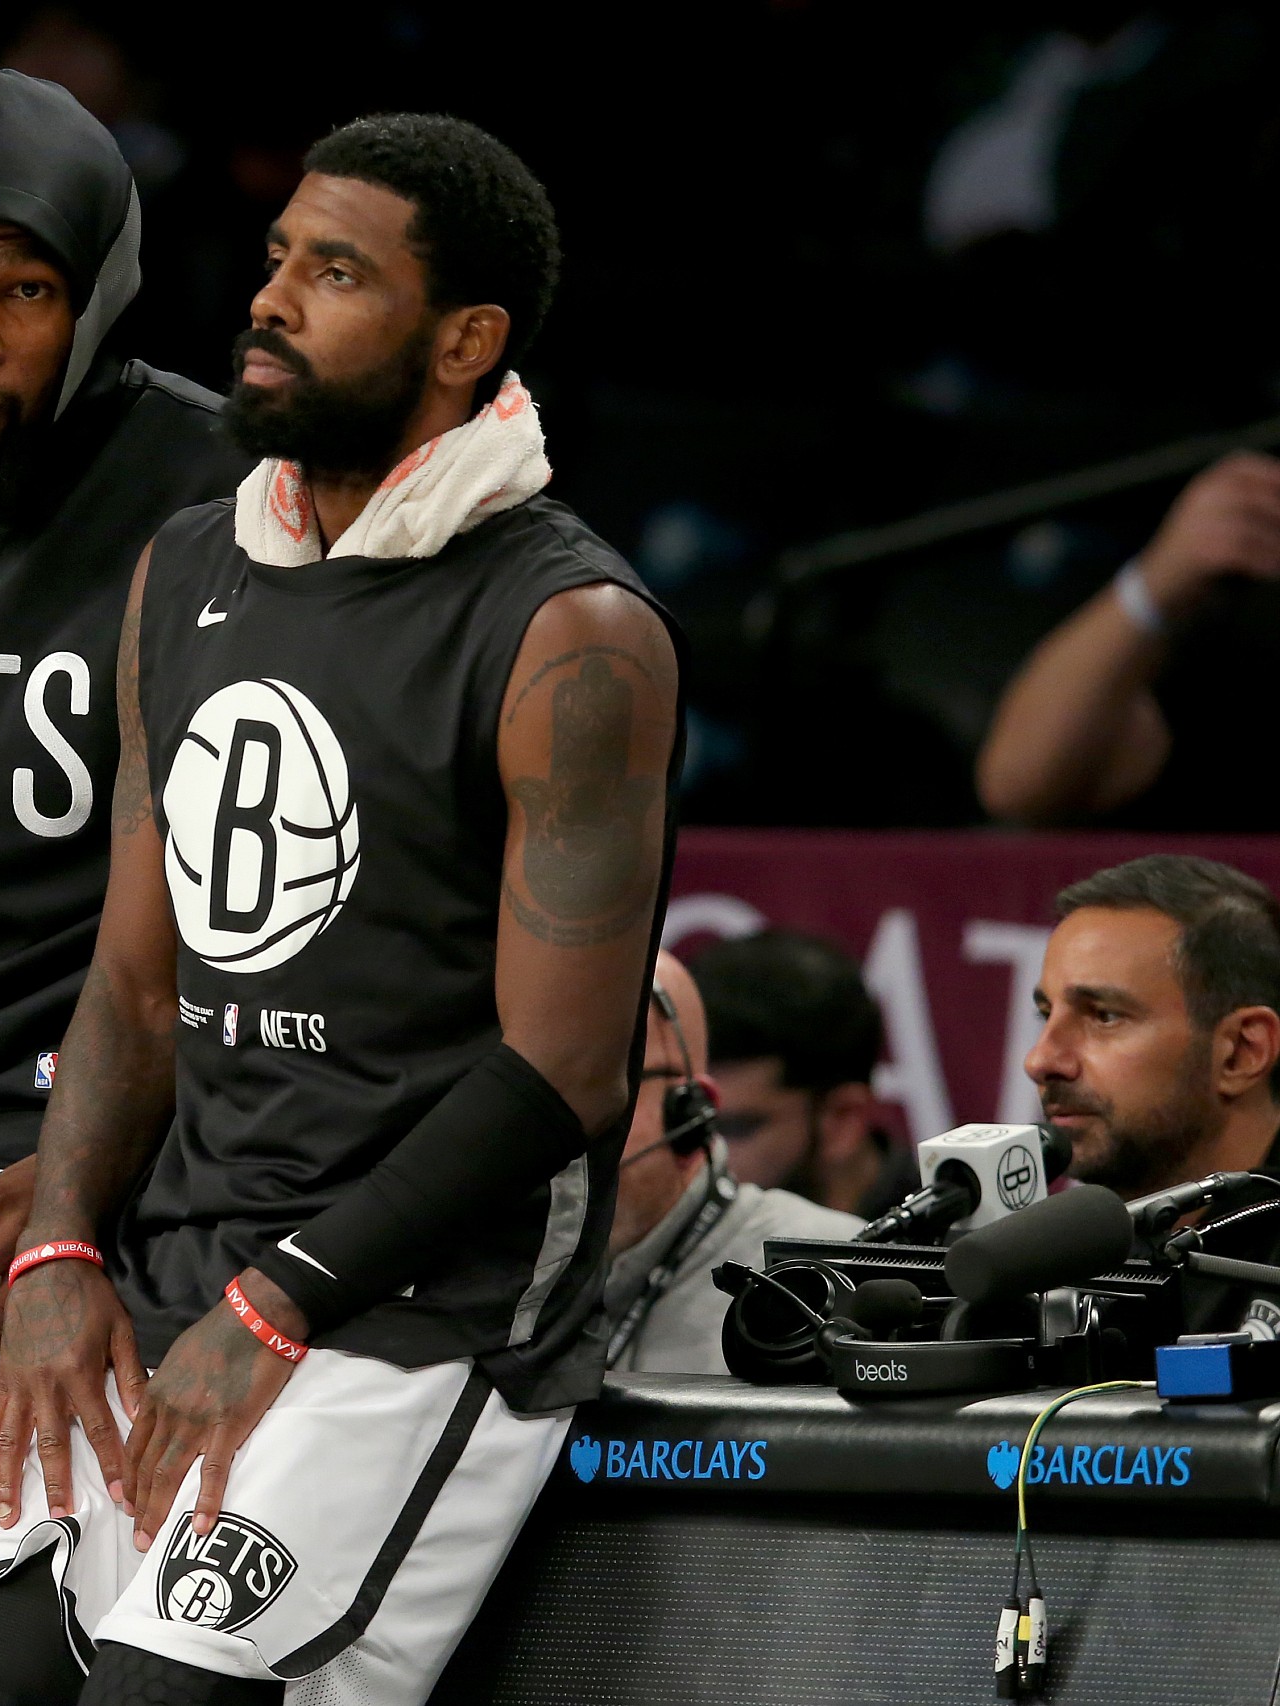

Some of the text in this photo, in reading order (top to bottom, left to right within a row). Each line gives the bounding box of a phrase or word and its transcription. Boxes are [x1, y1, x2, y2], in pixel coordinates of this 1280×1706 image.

[210, 717, 282, 933] B
[260, 1009, 326, 1053] NETS
[58, 1243, 94, 1257] Bryant
[855, 1359, 908, 1381] beats
[606, 1440, 767, 1480] BARCLAYS
[1026, 1445, 1192, 1487] BARCLAYS
[170, 1521, 283, 1599] NETS
[181, 1577, 216, 1622] B
